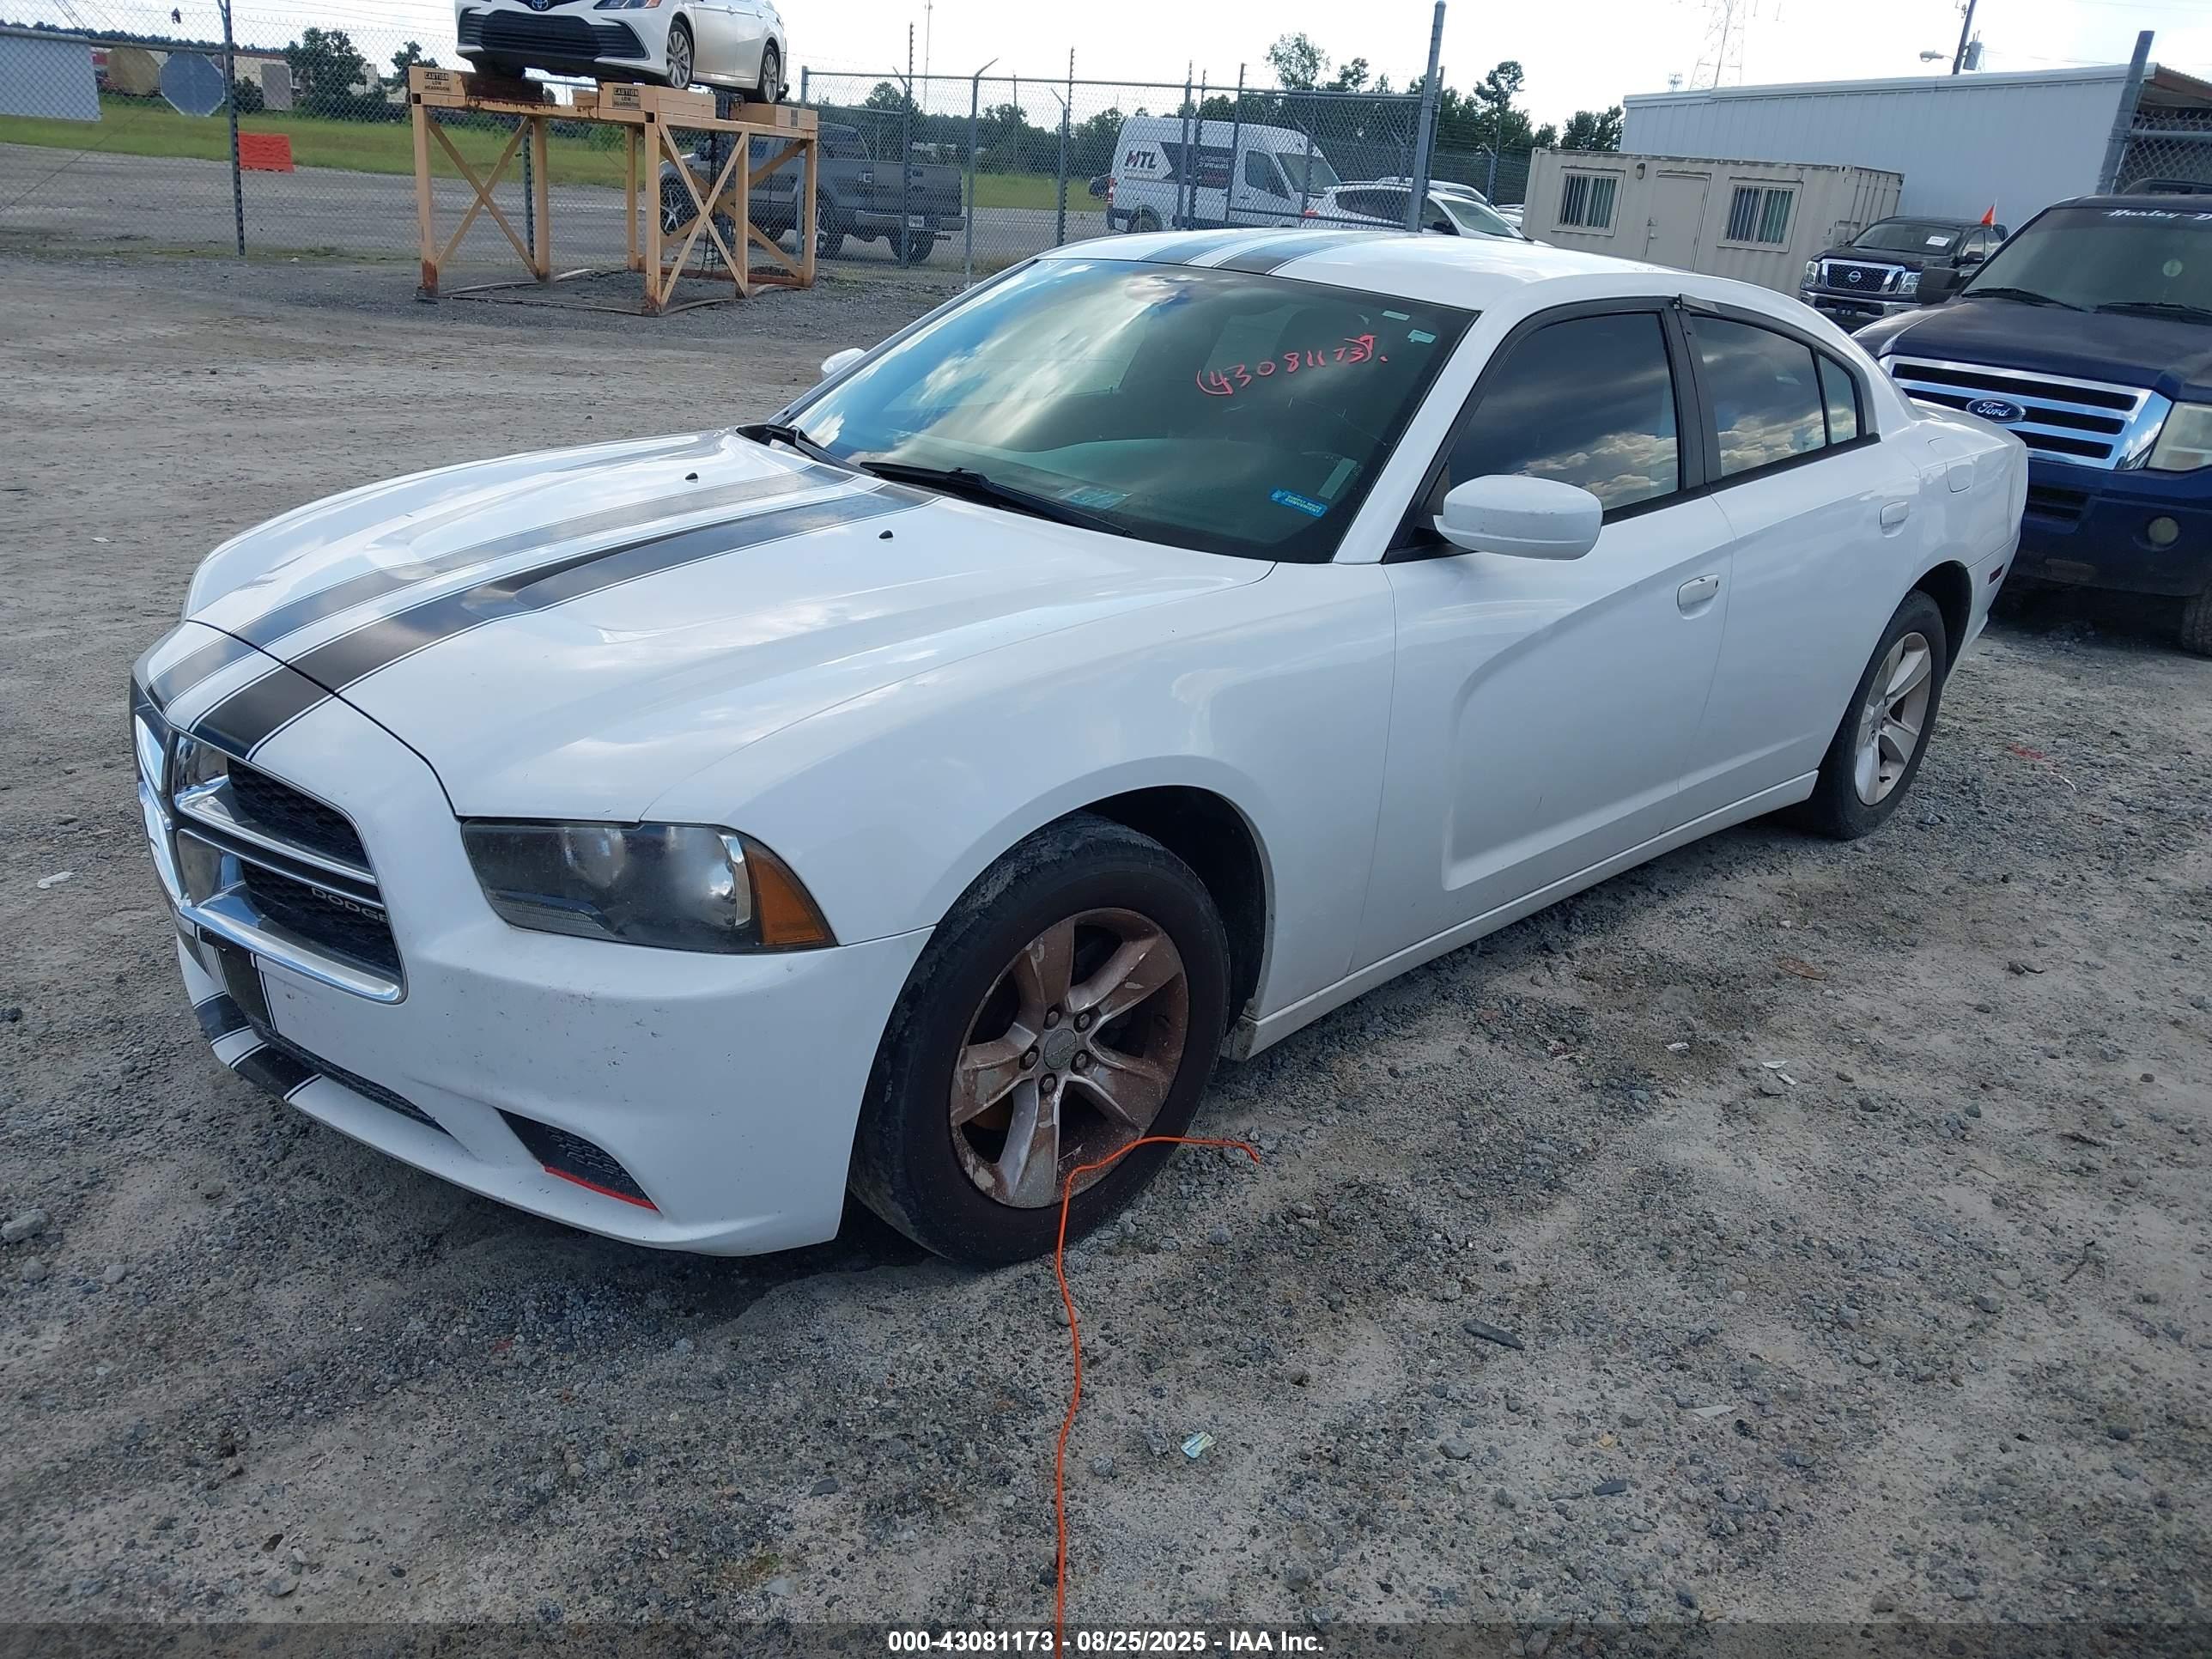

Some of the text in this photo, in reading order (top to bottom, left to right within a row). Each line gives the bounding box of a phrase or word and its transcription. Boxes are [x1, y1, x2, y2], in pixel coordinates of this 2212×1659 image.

[425, 72, 449, 81] CAUTION
[614, 88, 640, 96] CAUTION
[1125, 150, 1156, 169] MTL
[1977, 401, 2011, 417] Ford
[311, 886, 389, 924] DODGE
